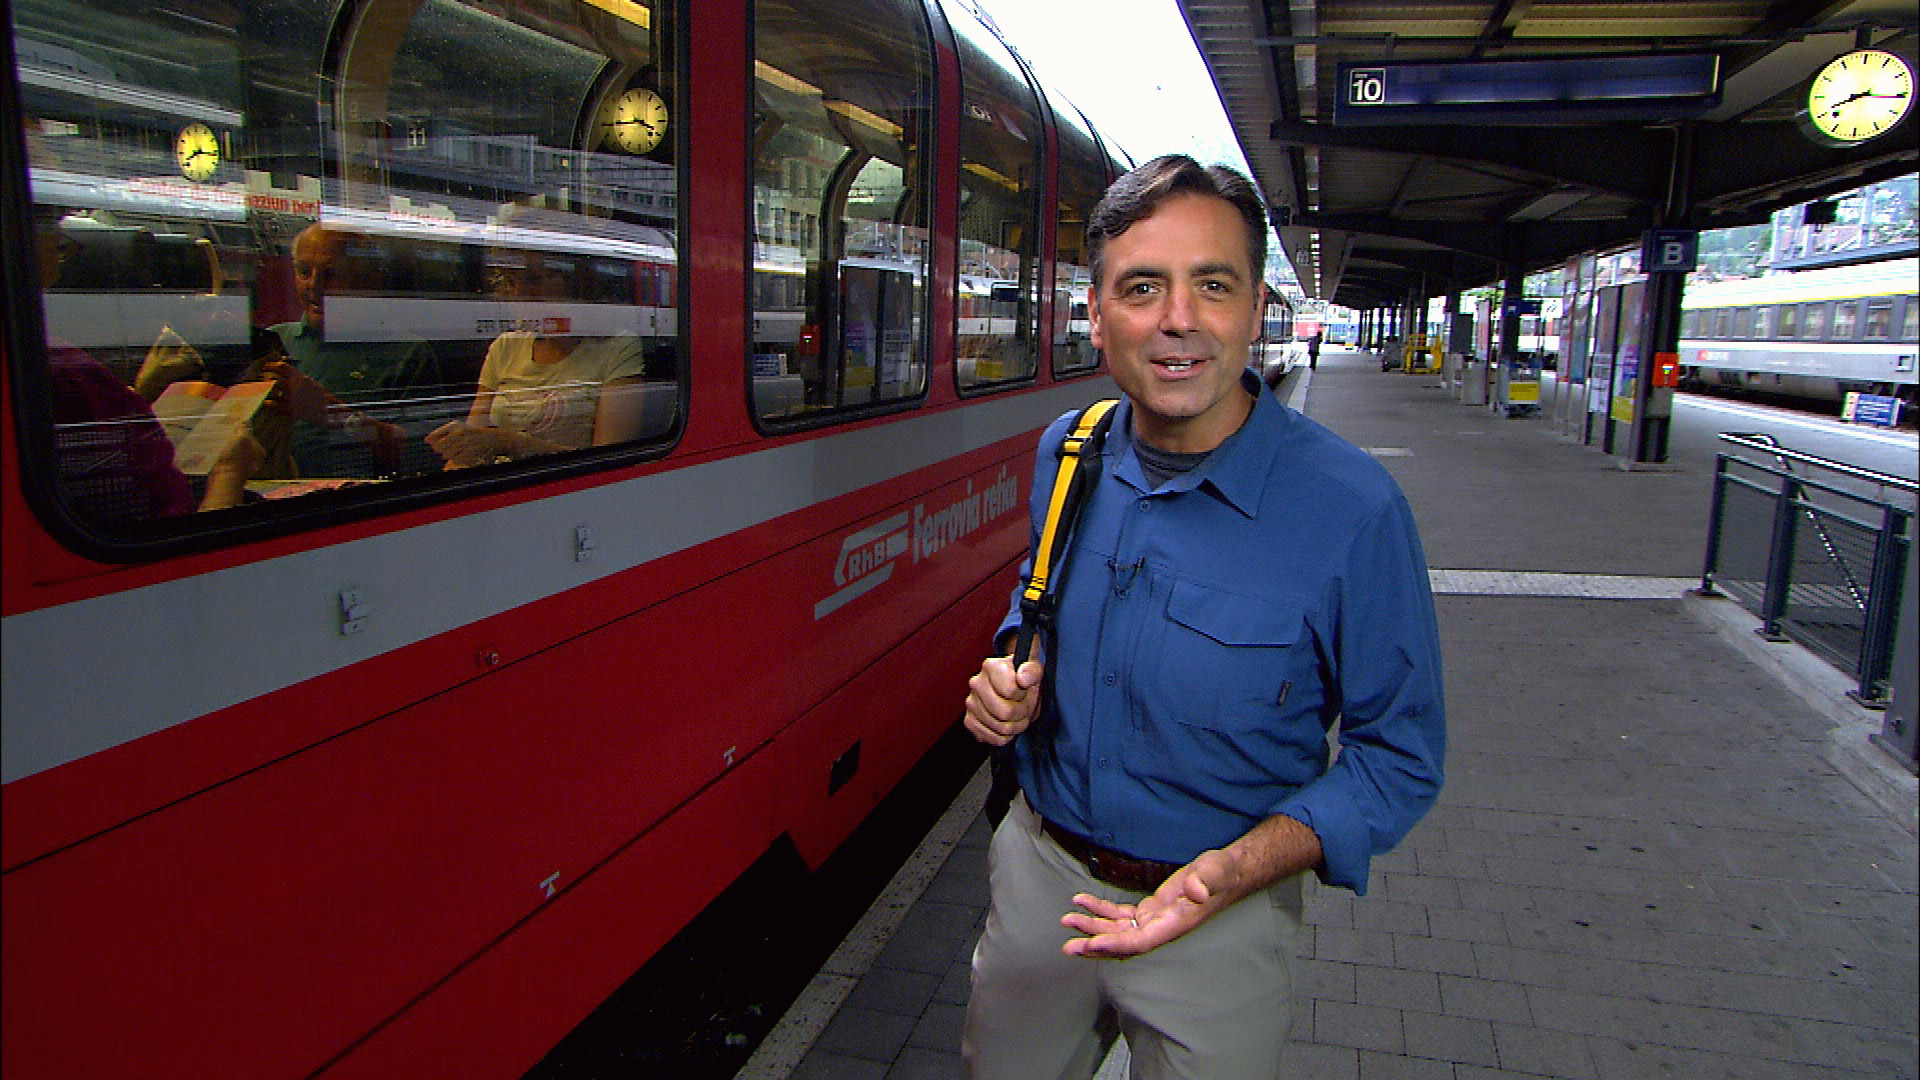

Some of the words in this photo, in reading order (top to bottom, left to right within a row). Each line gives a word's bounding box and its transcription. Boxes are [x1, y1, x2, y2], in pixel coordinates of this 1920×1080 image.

[1352, 79, 1381, 101] 10
[1664, 242, 1683, 264] B
[913, 479, 981, 565] Ferrovia
[848, 541, 885, 581] RhB
